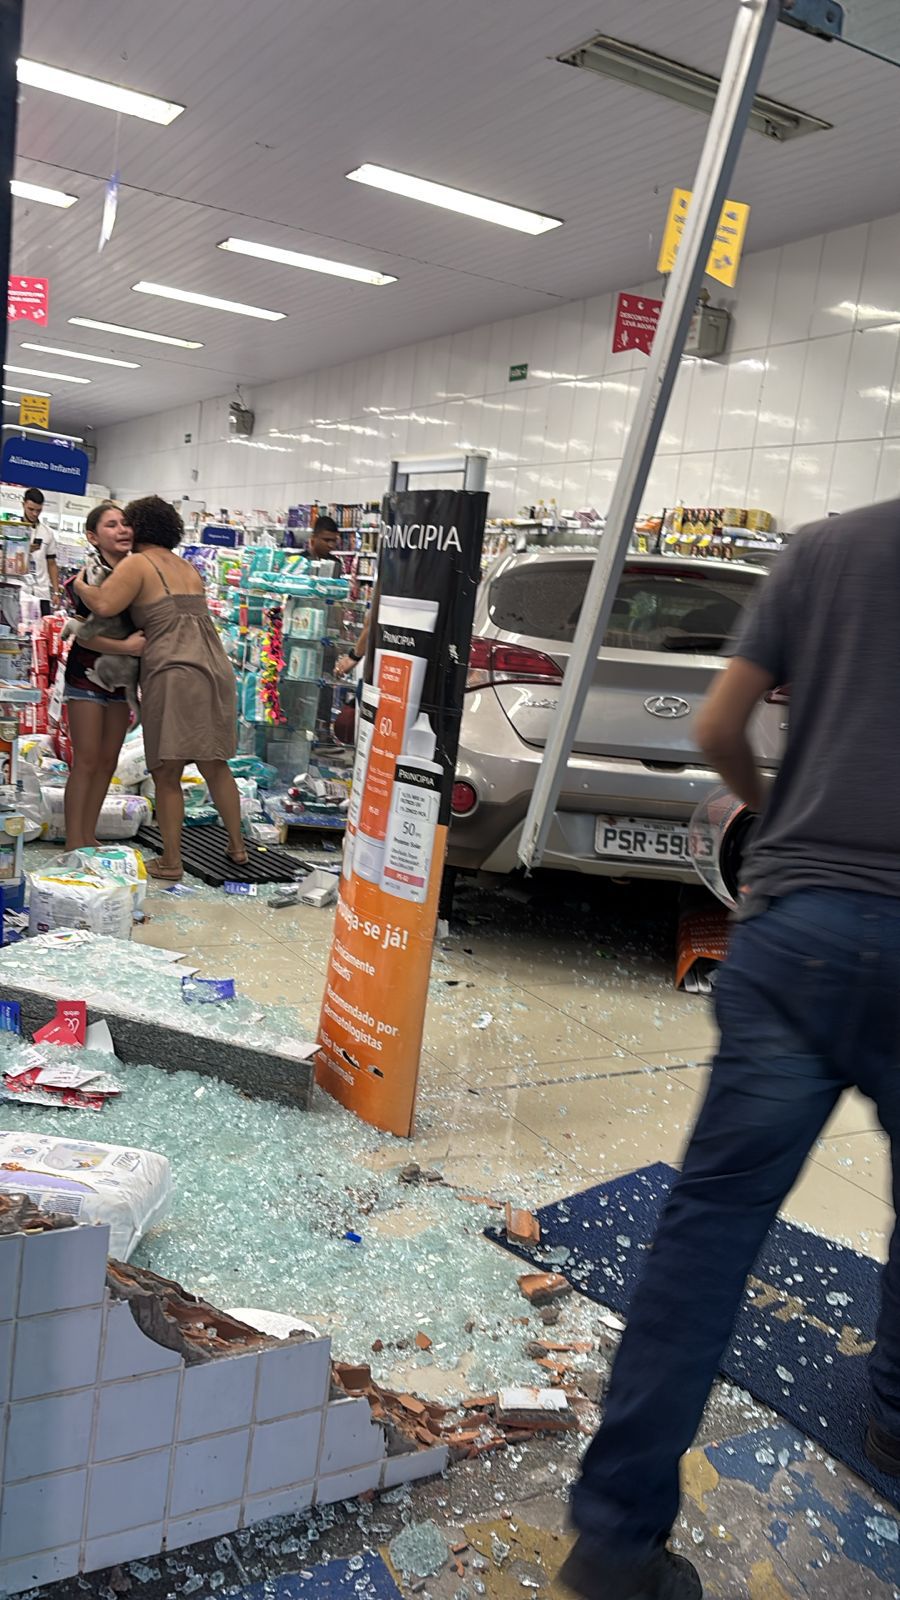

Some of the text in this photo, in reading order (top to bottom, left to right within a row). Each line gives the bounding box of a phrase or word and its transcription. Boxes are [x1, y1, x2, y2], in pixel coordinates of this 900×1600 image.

[9, 455, 81, 476] Alimento Infantil
[379, 520, 462, 553] PRINCIPIA
[383, 630, 416, 647] PRINCIPIA
[380, 716, 393, 738] 60
[398, 768, 435, 786] PRINCIPIA
[402, 821, 416, 836] 50
[381, 923, 409, 950] já!
[323, 1001, 383, 1051] dermatologistas
[376, 1020, 399, 1037] por
